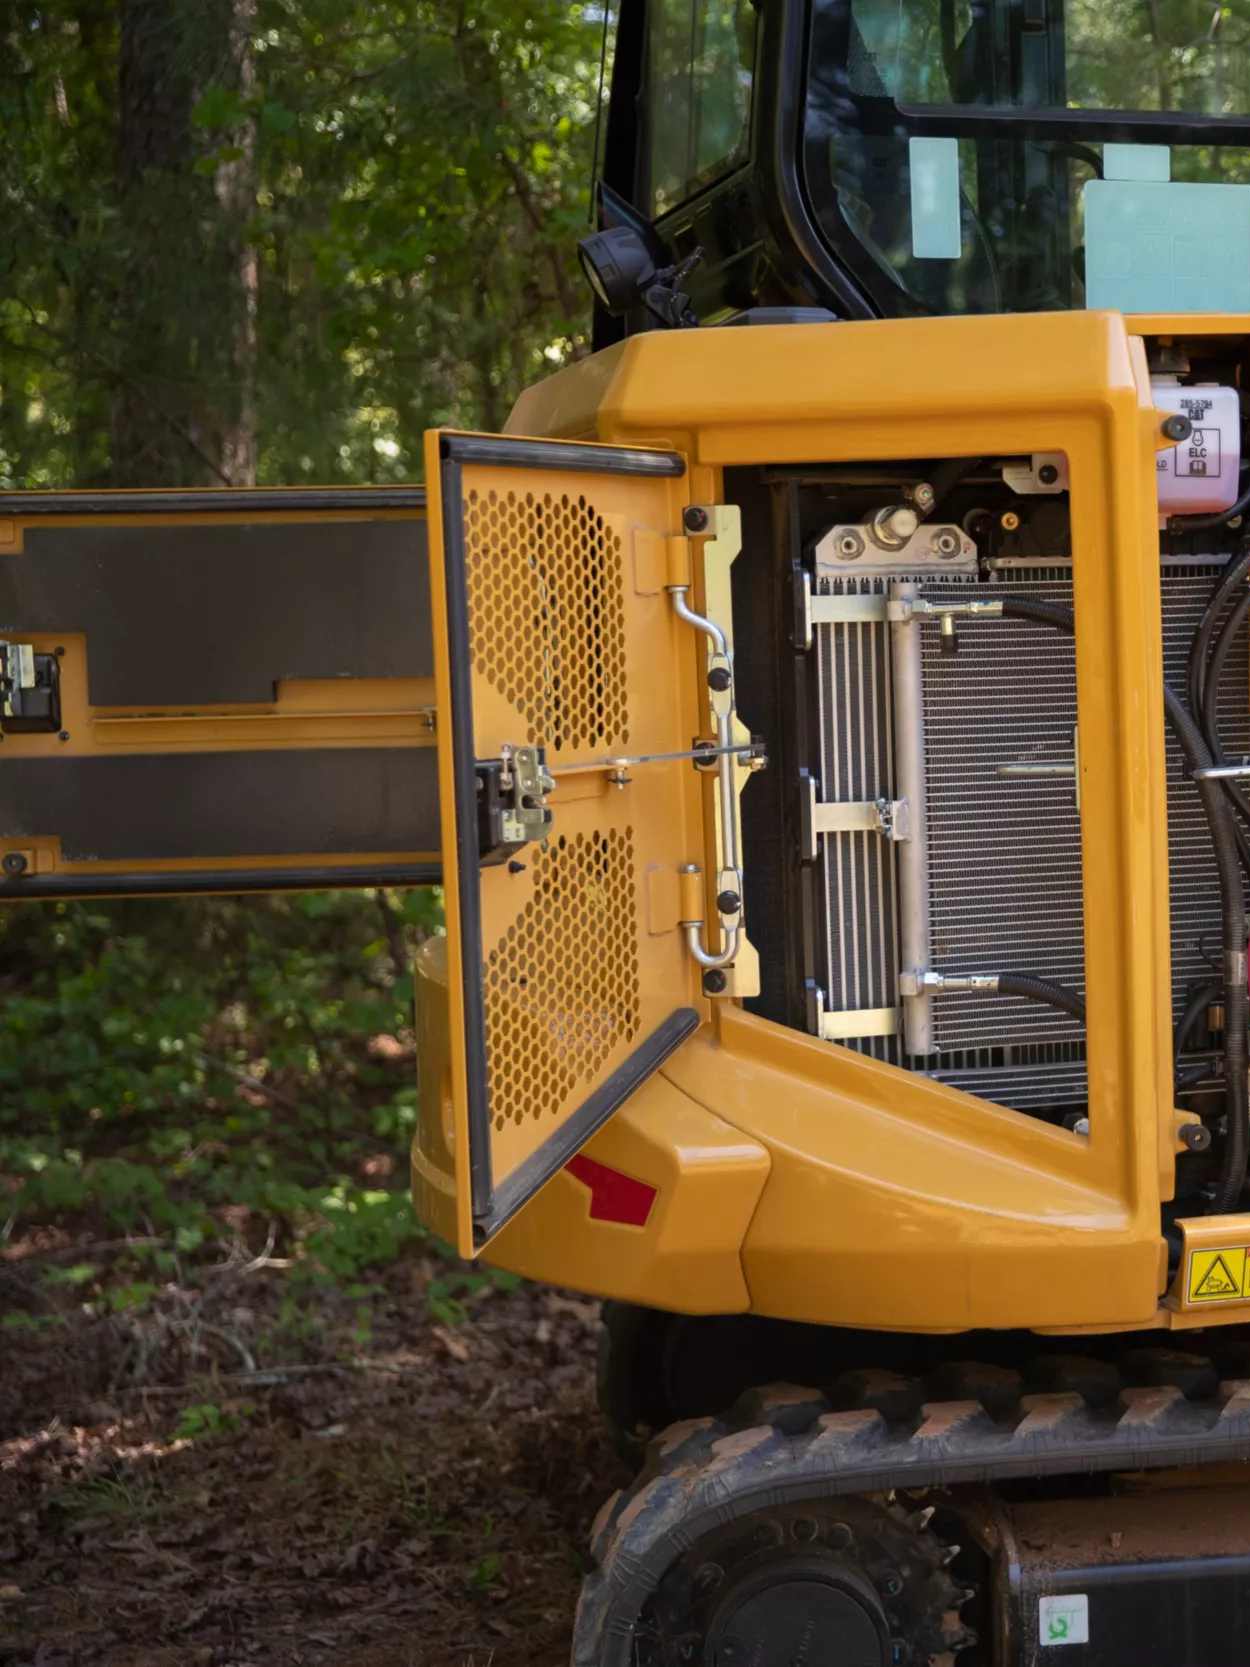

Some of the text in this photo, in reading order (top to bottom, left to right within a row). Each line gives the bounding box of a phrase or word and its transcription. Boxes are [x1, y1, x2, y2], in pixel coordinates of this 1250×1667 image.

[1180, 399, 1212, 409] 285-5794
[1188, 409, 1205, 420] CAT
[1188, 448, 1207, 458] ELC
[1156, 460, 1167, 468] LD
